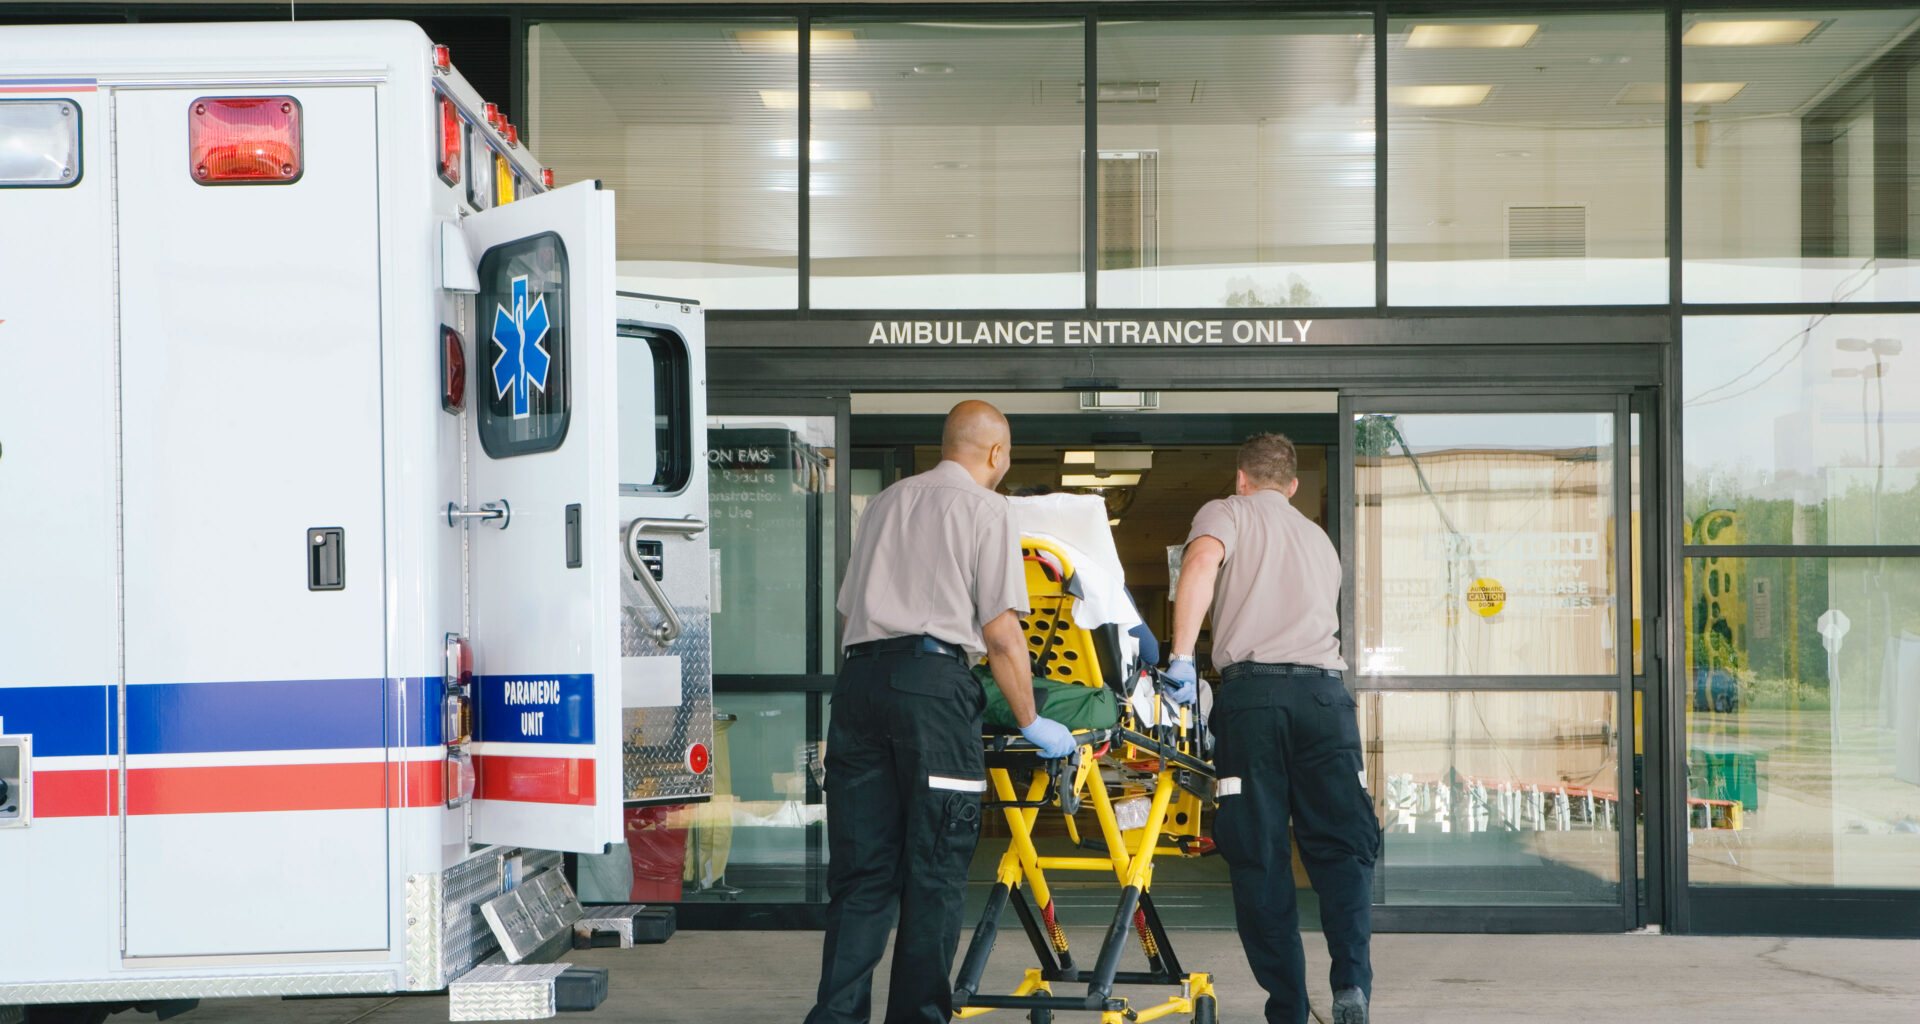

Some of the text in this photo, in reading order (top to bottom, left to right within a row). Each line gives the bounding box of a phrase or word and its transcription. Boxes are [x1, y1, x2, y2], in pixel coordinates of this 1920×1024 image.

[868, 319, 1313, 344] AMBULANCE ENTRANCE ONLY
[1469, 593, 1504, 601] CAUTION
[504, 680, 560, 706] PARAMEDIC
[520, 711, 544, 736] UNIT
